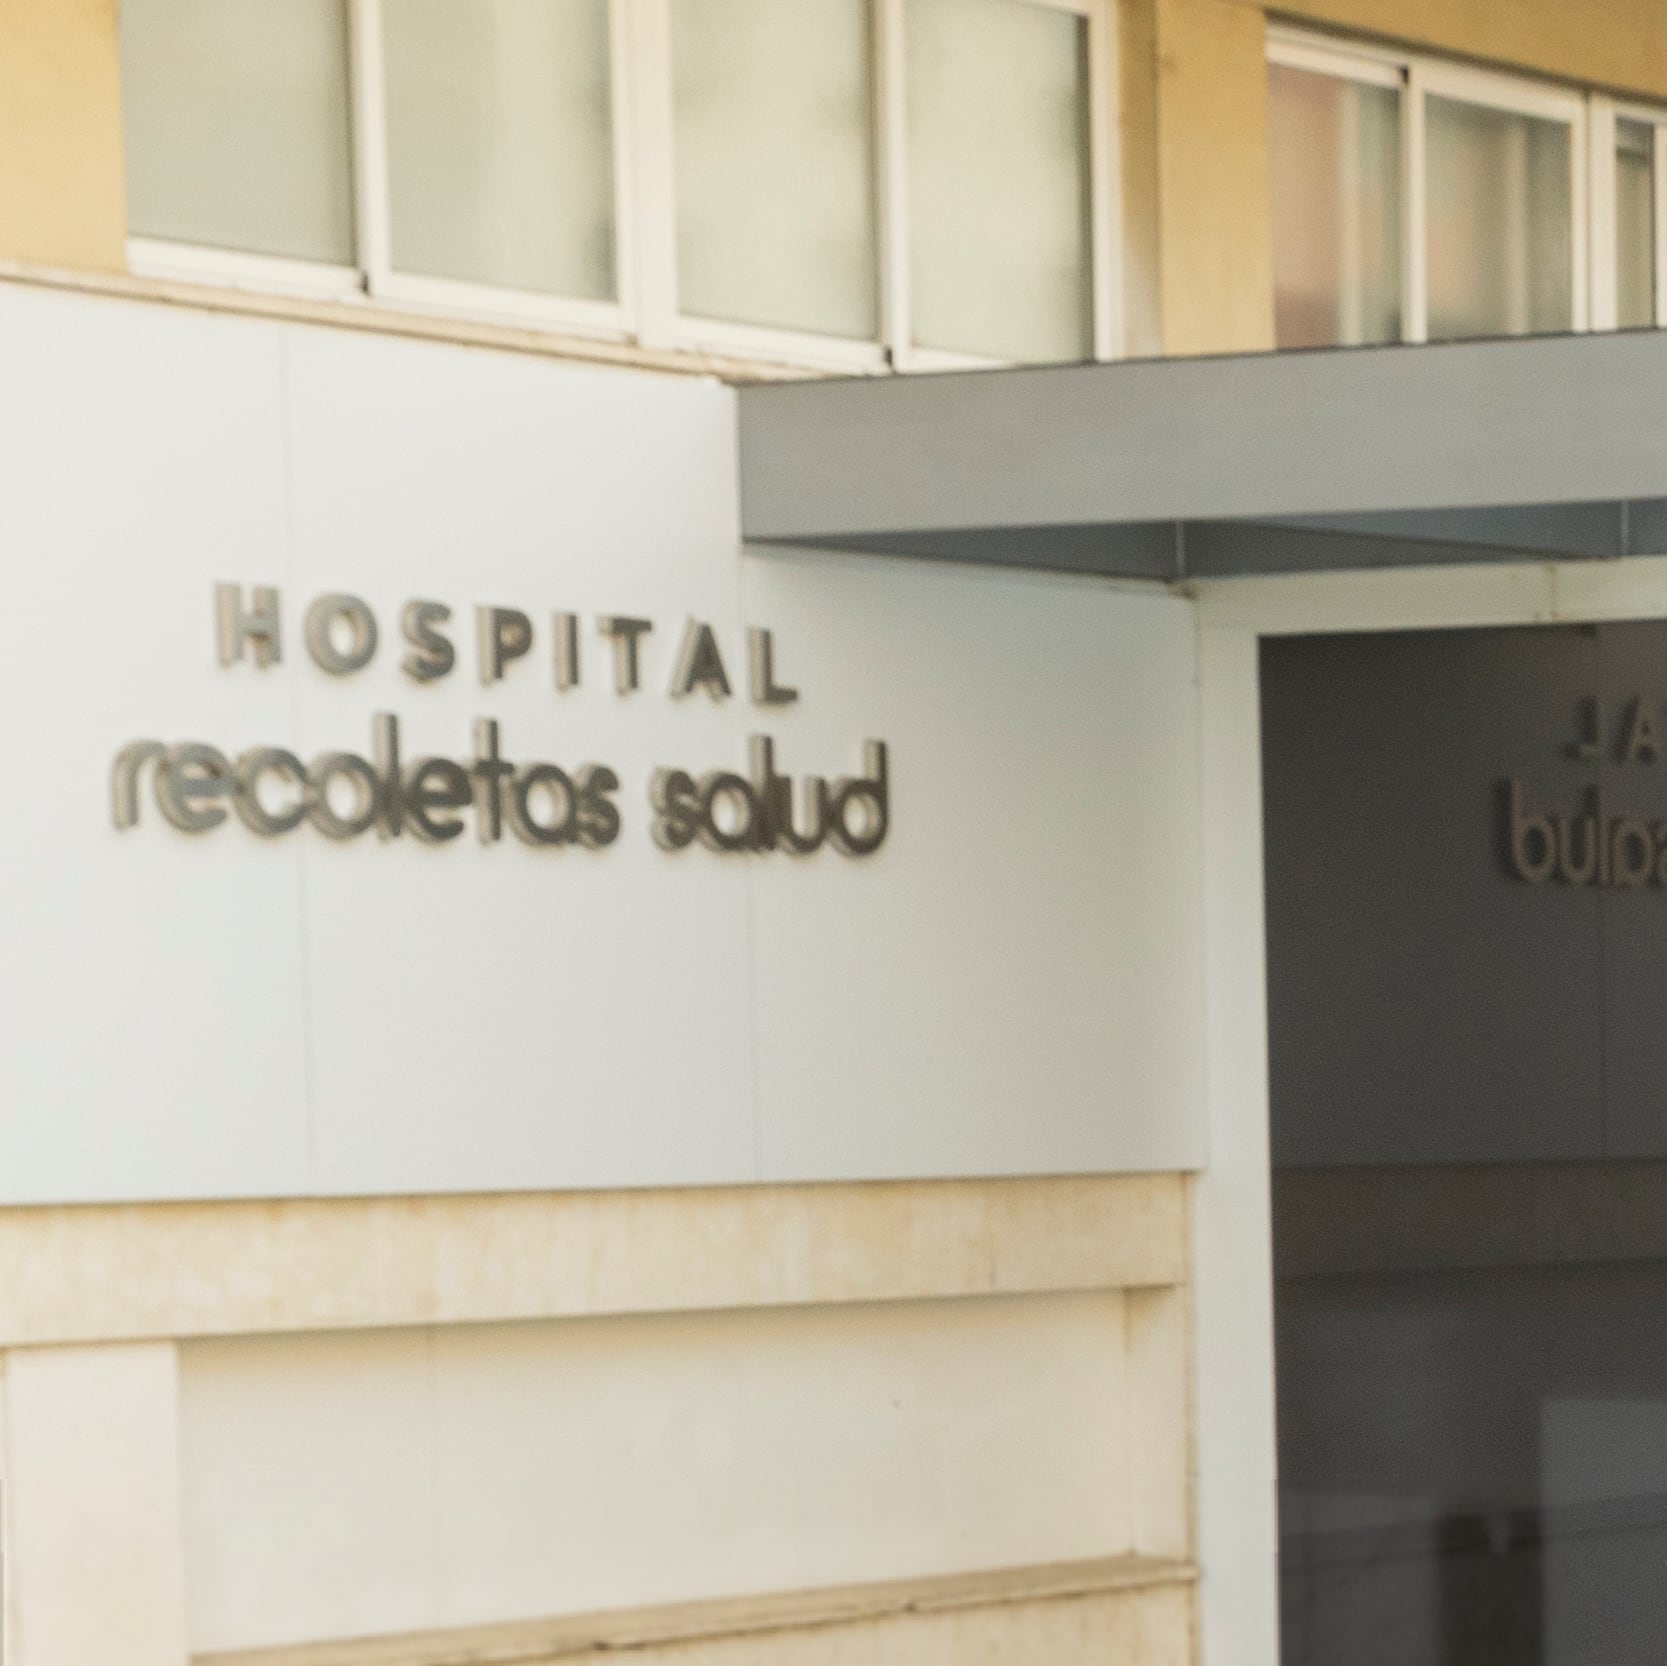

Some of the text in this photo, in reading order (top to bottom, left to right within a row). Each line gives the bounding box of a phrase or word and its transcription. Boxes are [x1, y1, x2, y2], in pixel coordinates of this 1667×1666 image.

[213, 580, 799, 705] HOSPITAL
[110, 711, 890, 857] recoletas salud
